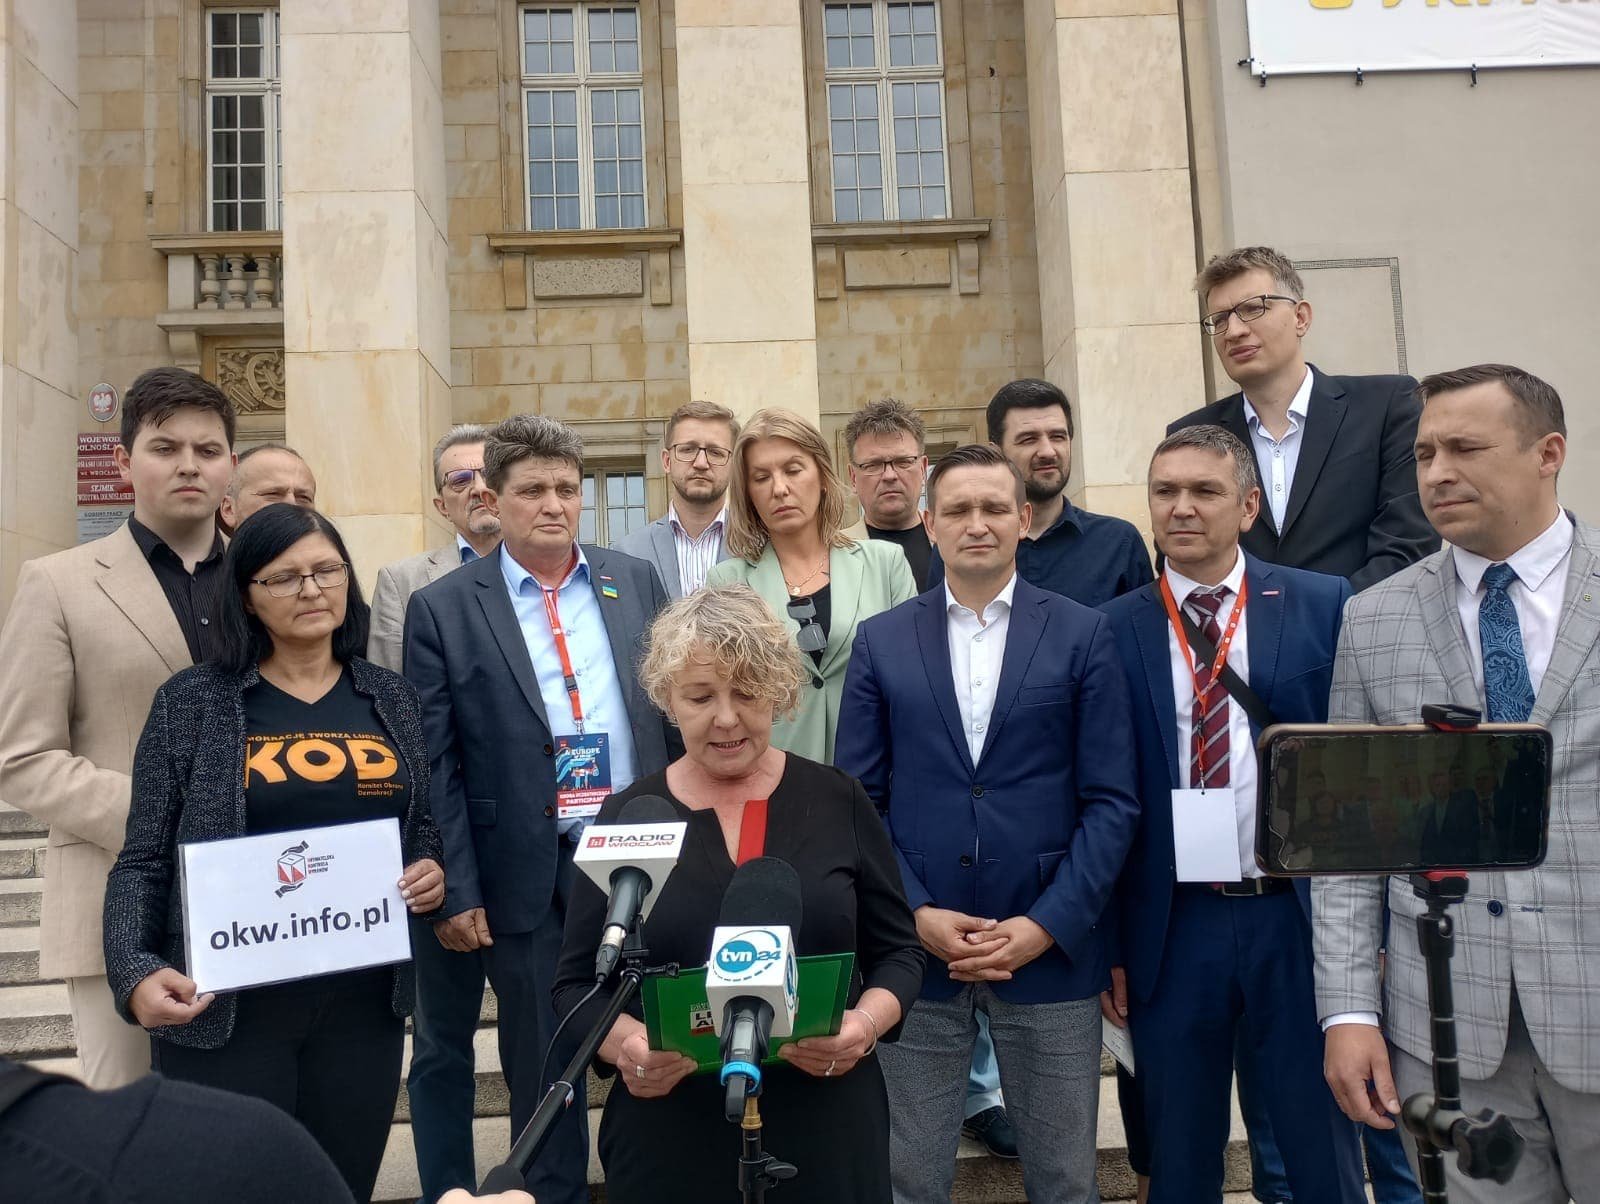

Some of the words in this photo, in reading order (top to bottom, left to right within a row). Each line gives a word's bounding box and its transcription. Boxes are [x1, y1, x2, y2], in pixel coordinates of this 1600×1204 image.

[79, 436, 121, 444] WOJEWOD
[90, 484, 115, 492] SEJMIK
[572, 747, 601, 756] EUROPE
[243, 739, 398, 789] KOD
[608, 833, 676, 843] RADIO
[209, 897, 390, 950] okw.info.pl
